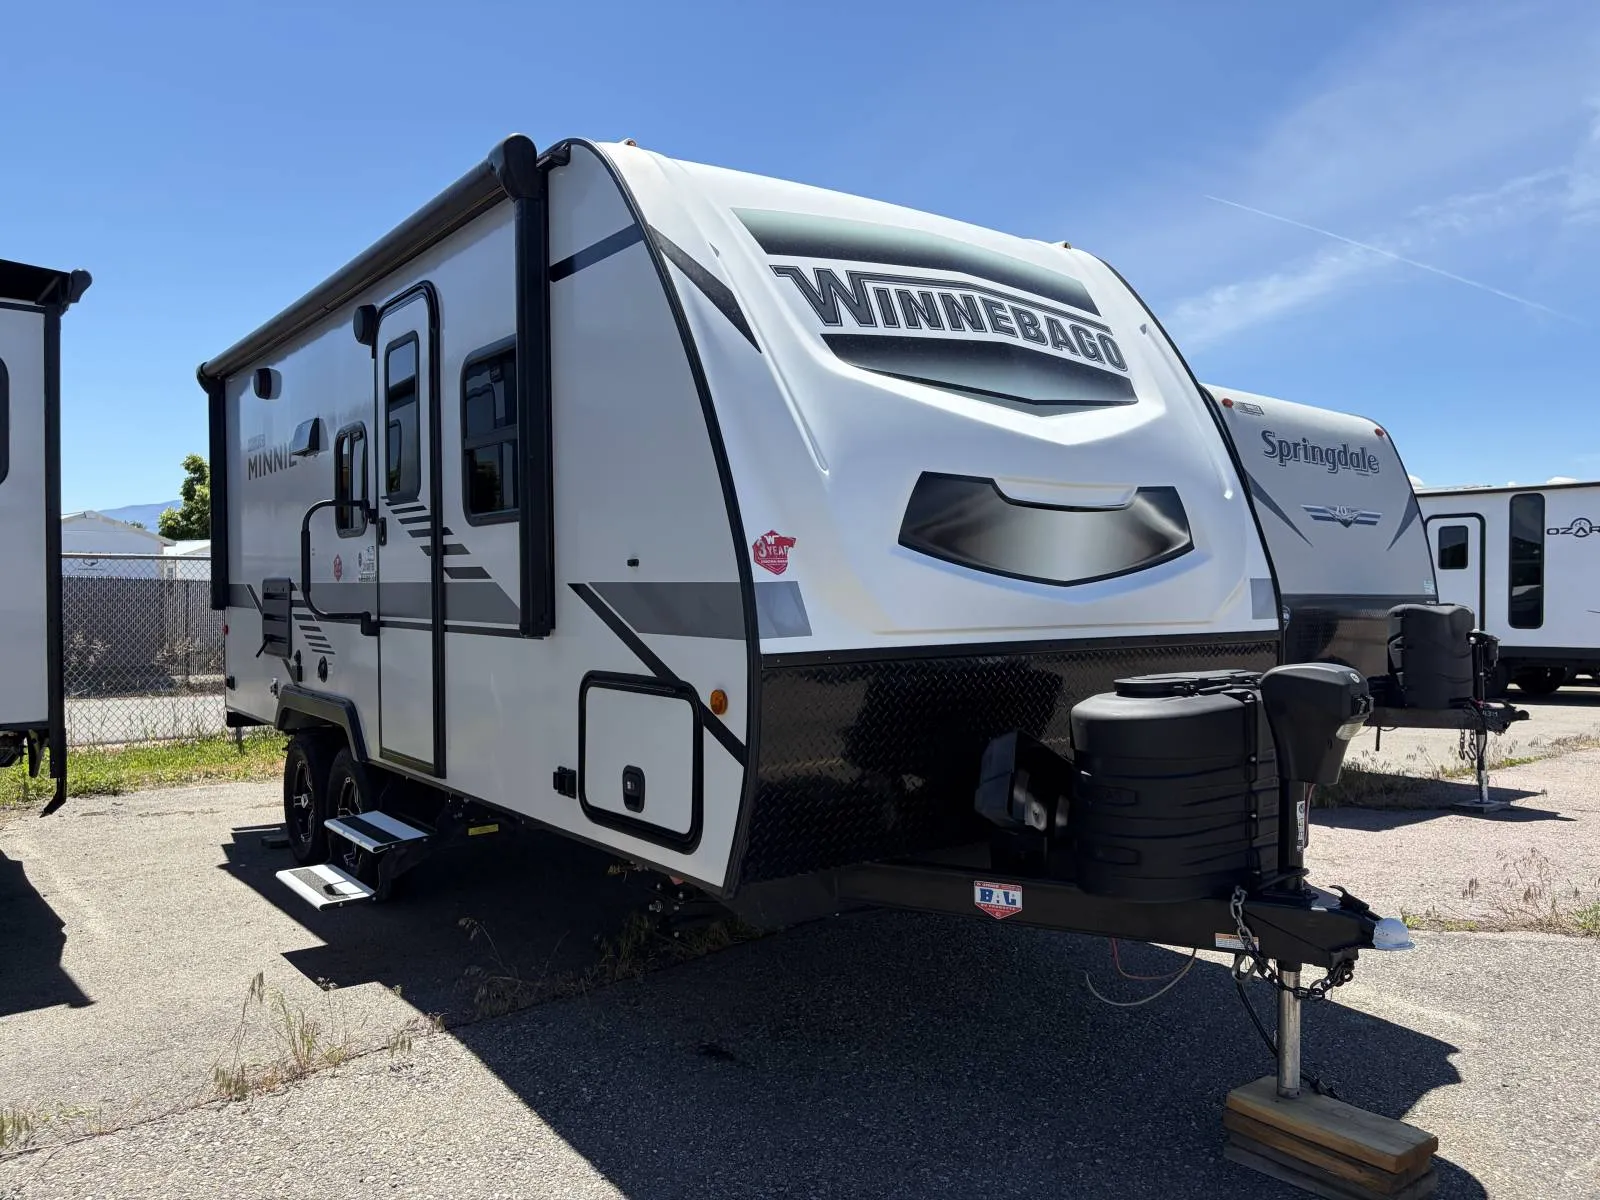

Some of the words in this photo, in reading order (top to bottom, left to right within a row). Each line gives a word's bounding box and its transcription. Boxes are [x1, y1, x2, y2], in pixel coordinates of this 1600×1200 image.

[769, 264, 1129, 372] WINNEBAGO
[1261, 430, 1380, 474] Springdale
[757, 540, 767, 558] 3
[980, 888, 1016, 906] BAL
